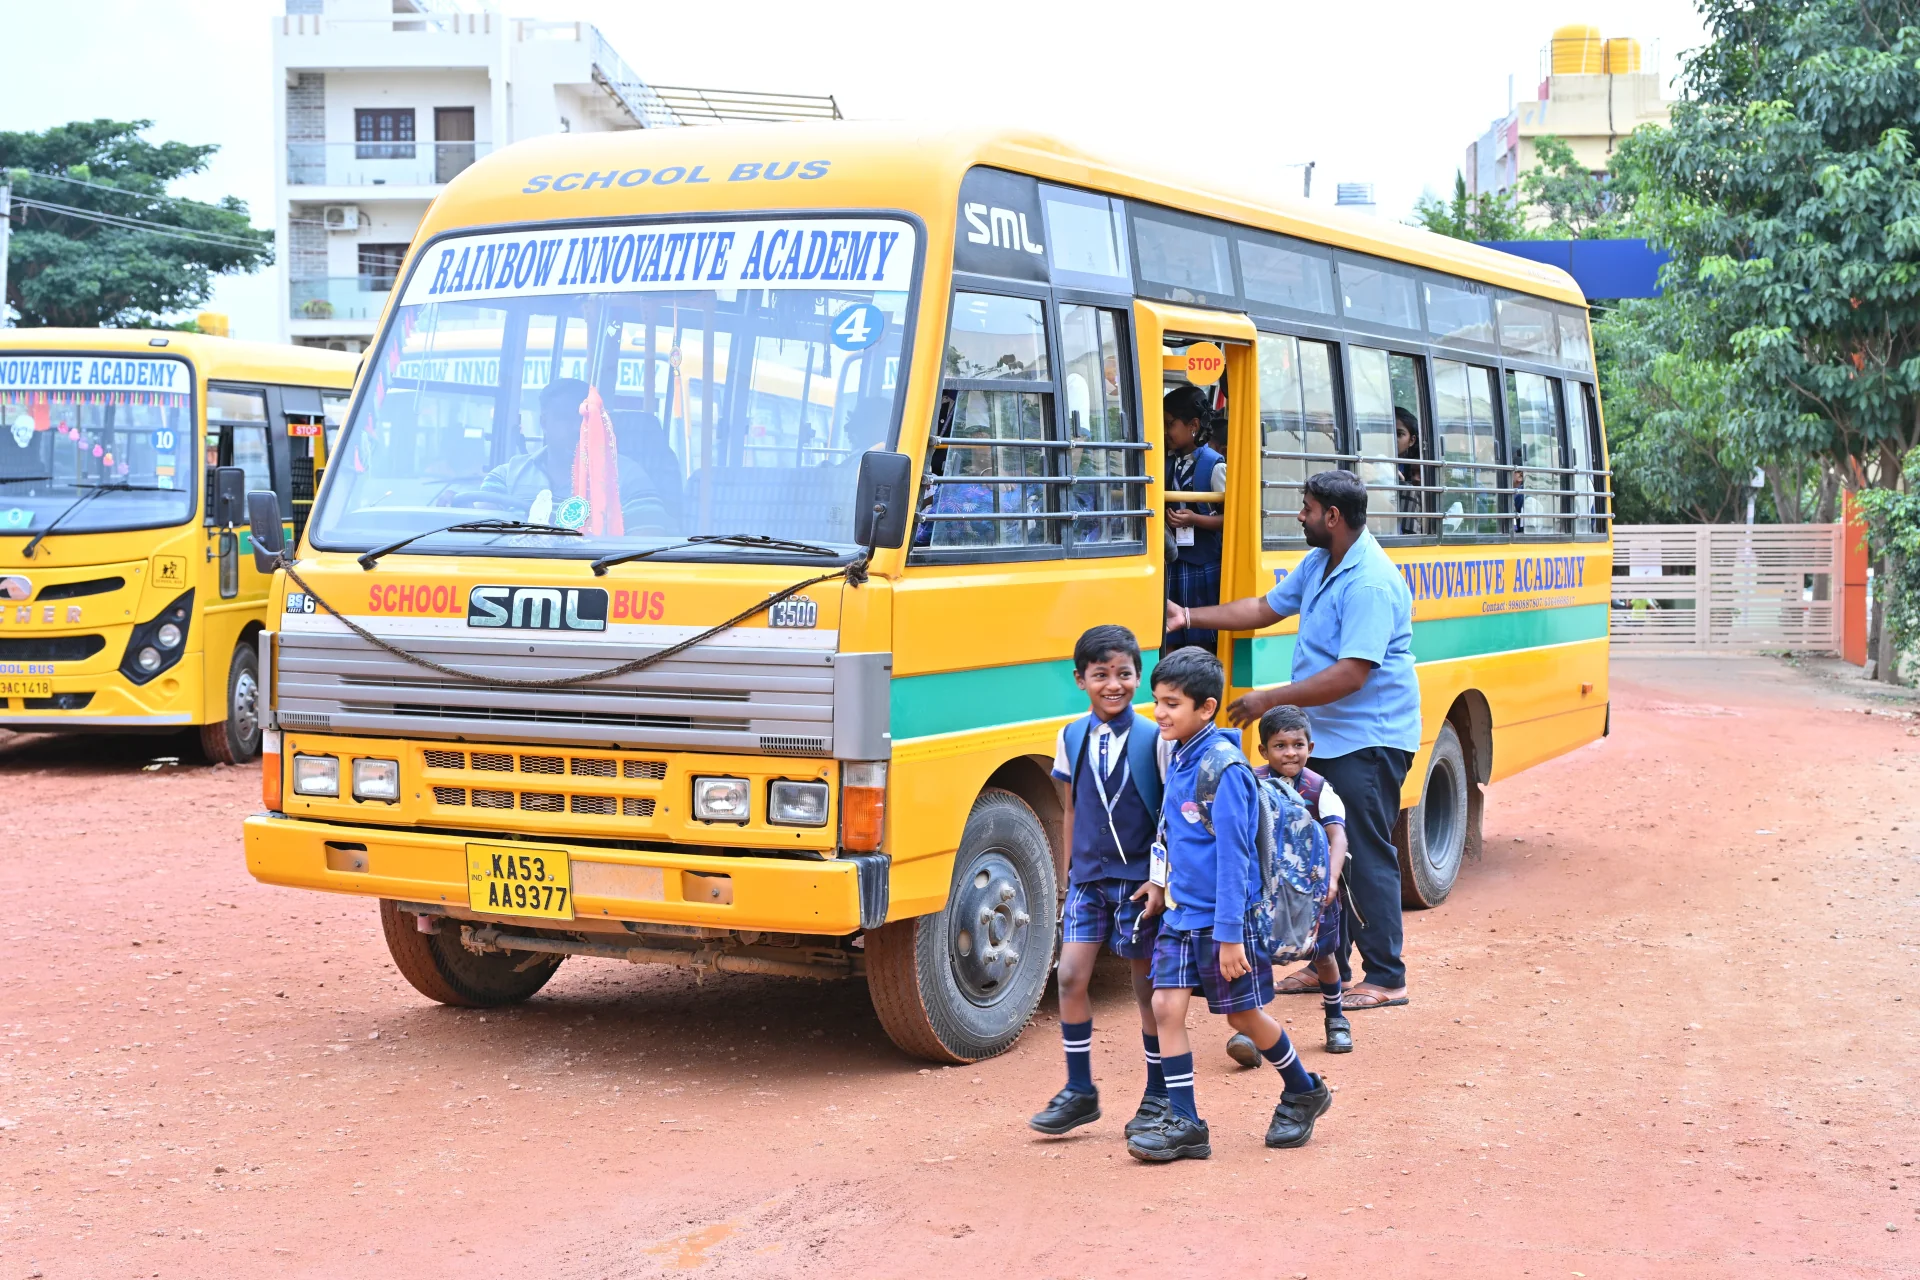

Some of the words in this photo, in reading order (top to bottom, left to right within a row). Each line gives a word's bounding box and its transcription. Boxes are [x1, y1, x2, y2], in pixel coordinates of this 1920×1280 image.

[521, 165, 712, 194] SCHOOL
[727, 159, 832, 182] BUS
[964, 202, 1044, 255] SML
[428, 238, 564, 295] RAINBOW
[557, 231, 736, 285] INNOVATIVE
[740, 229, 900, 281] ACADEMY
[835, 307, 872, 343] 4
[88, 361, 177, 388] ACADEMY
[1188, 357, 1221, 371] STOP
[156, 431, 174, 449] 10
[295, 425, 318, 435] STOP
[1395, 559, 1505, 601] NNOVATIVE
[1513, 556, 1585, 593] ACADEMY
[368, 584, 462, 614] SCHOOL
[469, 588, 605, 631] SML
[612, 589, 665, 621] BUS
[28, 664, 55, 674] BUS
[471, 874, 483, 882] IND
[491, 853, 546, 882] KA53
[488, 881, 567, 912] AA9377
